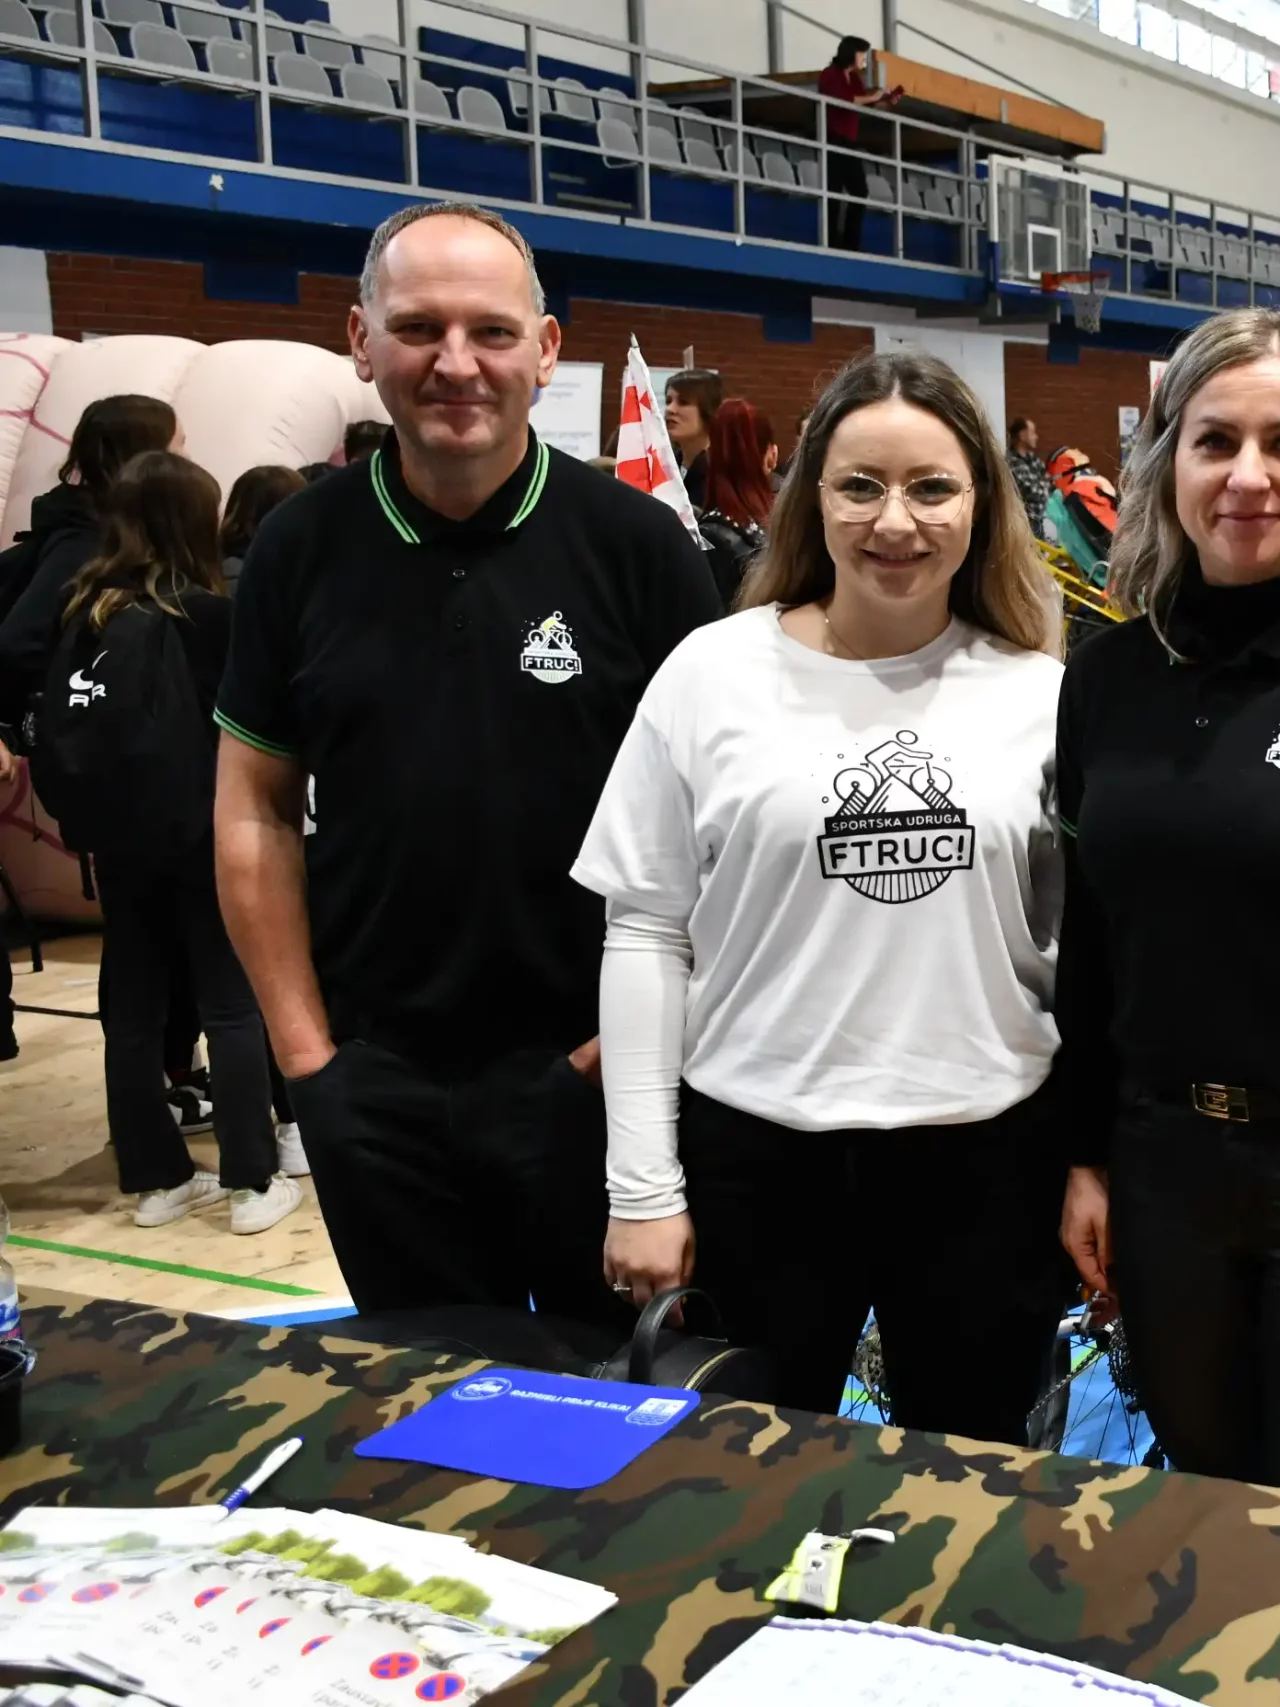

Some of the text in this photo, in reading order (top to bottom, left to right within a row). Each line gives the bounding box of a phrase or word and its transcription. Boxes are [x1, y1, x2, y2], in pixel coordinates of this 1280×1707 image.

[525, 657, 578, 671] FTRUC!
[832, 814, 961, 832] SPORTSKA UDRUGA
[829, 835, 964, 869] FTRUC!
